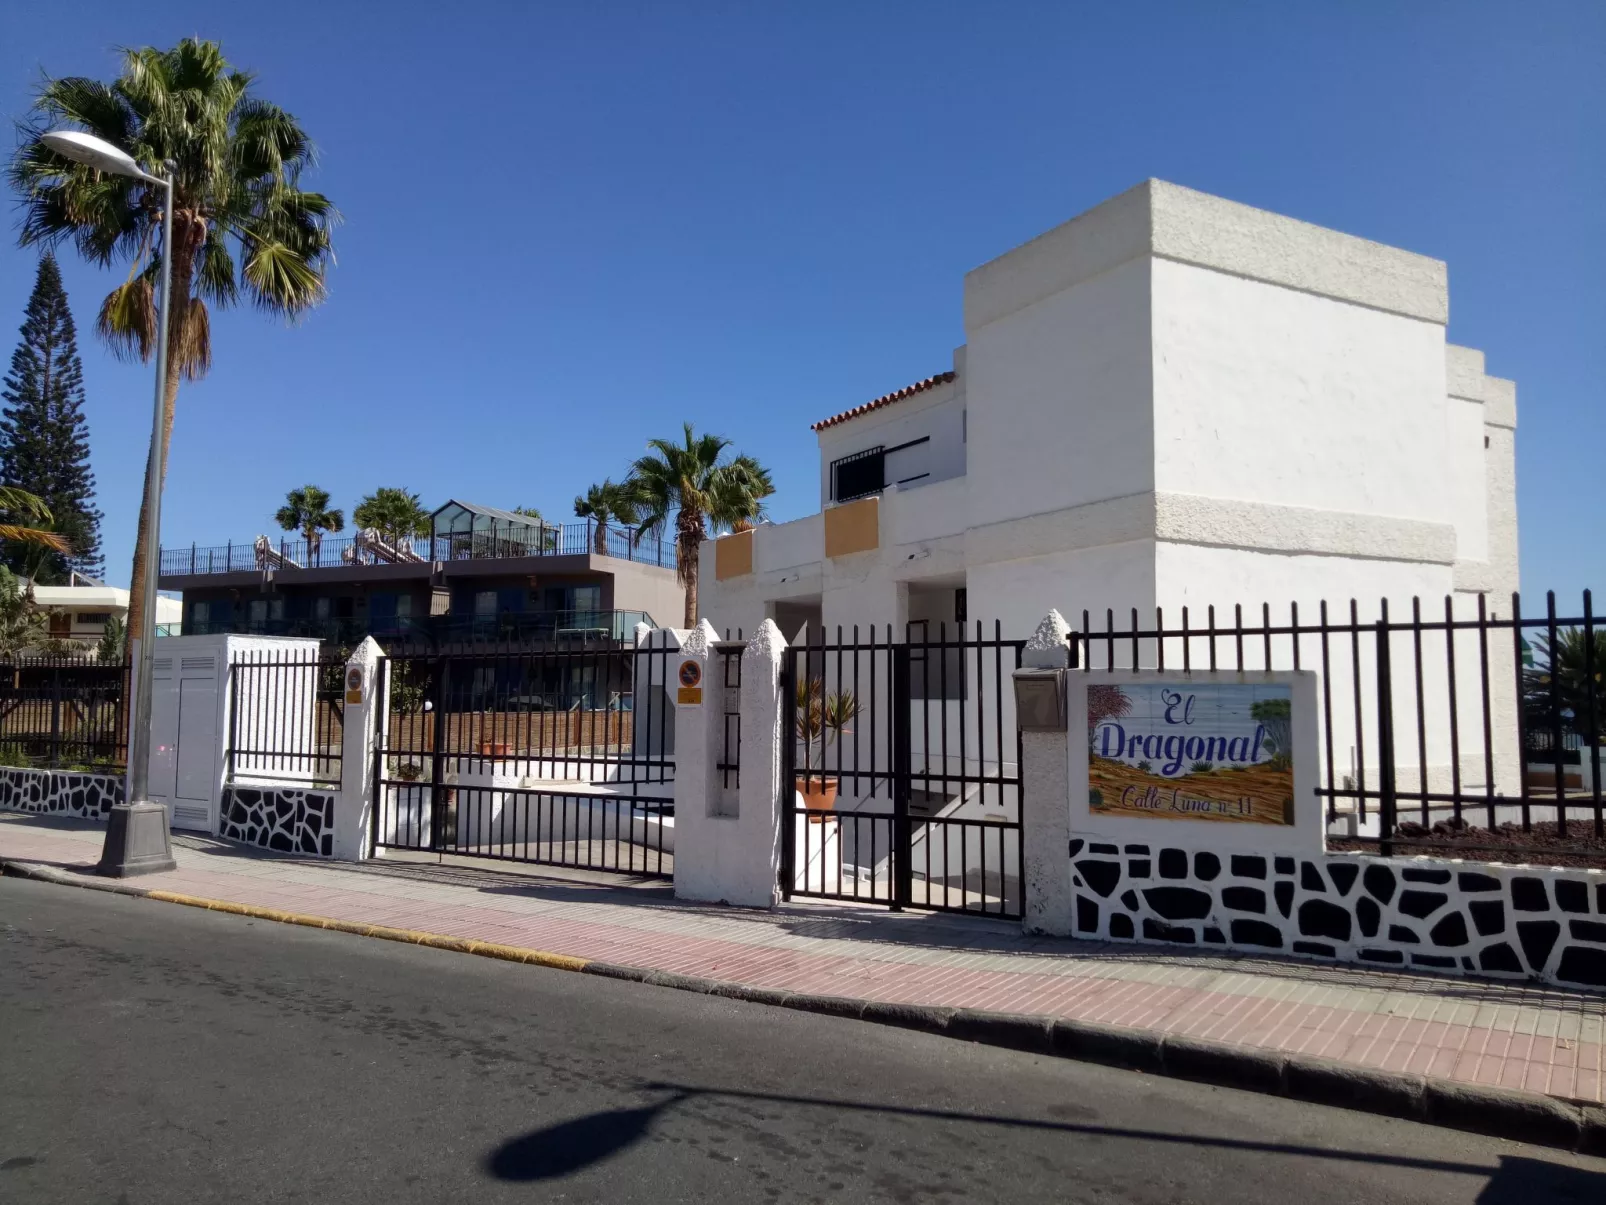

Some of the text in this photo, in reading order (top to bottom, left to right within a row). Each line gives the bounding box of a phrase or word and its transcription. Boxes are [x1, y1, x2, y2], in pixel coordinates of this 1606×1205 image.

[1161, 688, 1195, 725] El
[1096, 722, 1266, 776] Dragonal
[1120, 785, 1162, 809] Calle
[1169, 787, 1210, 813] Luna
[1238, 797, 1251, 814] 11
